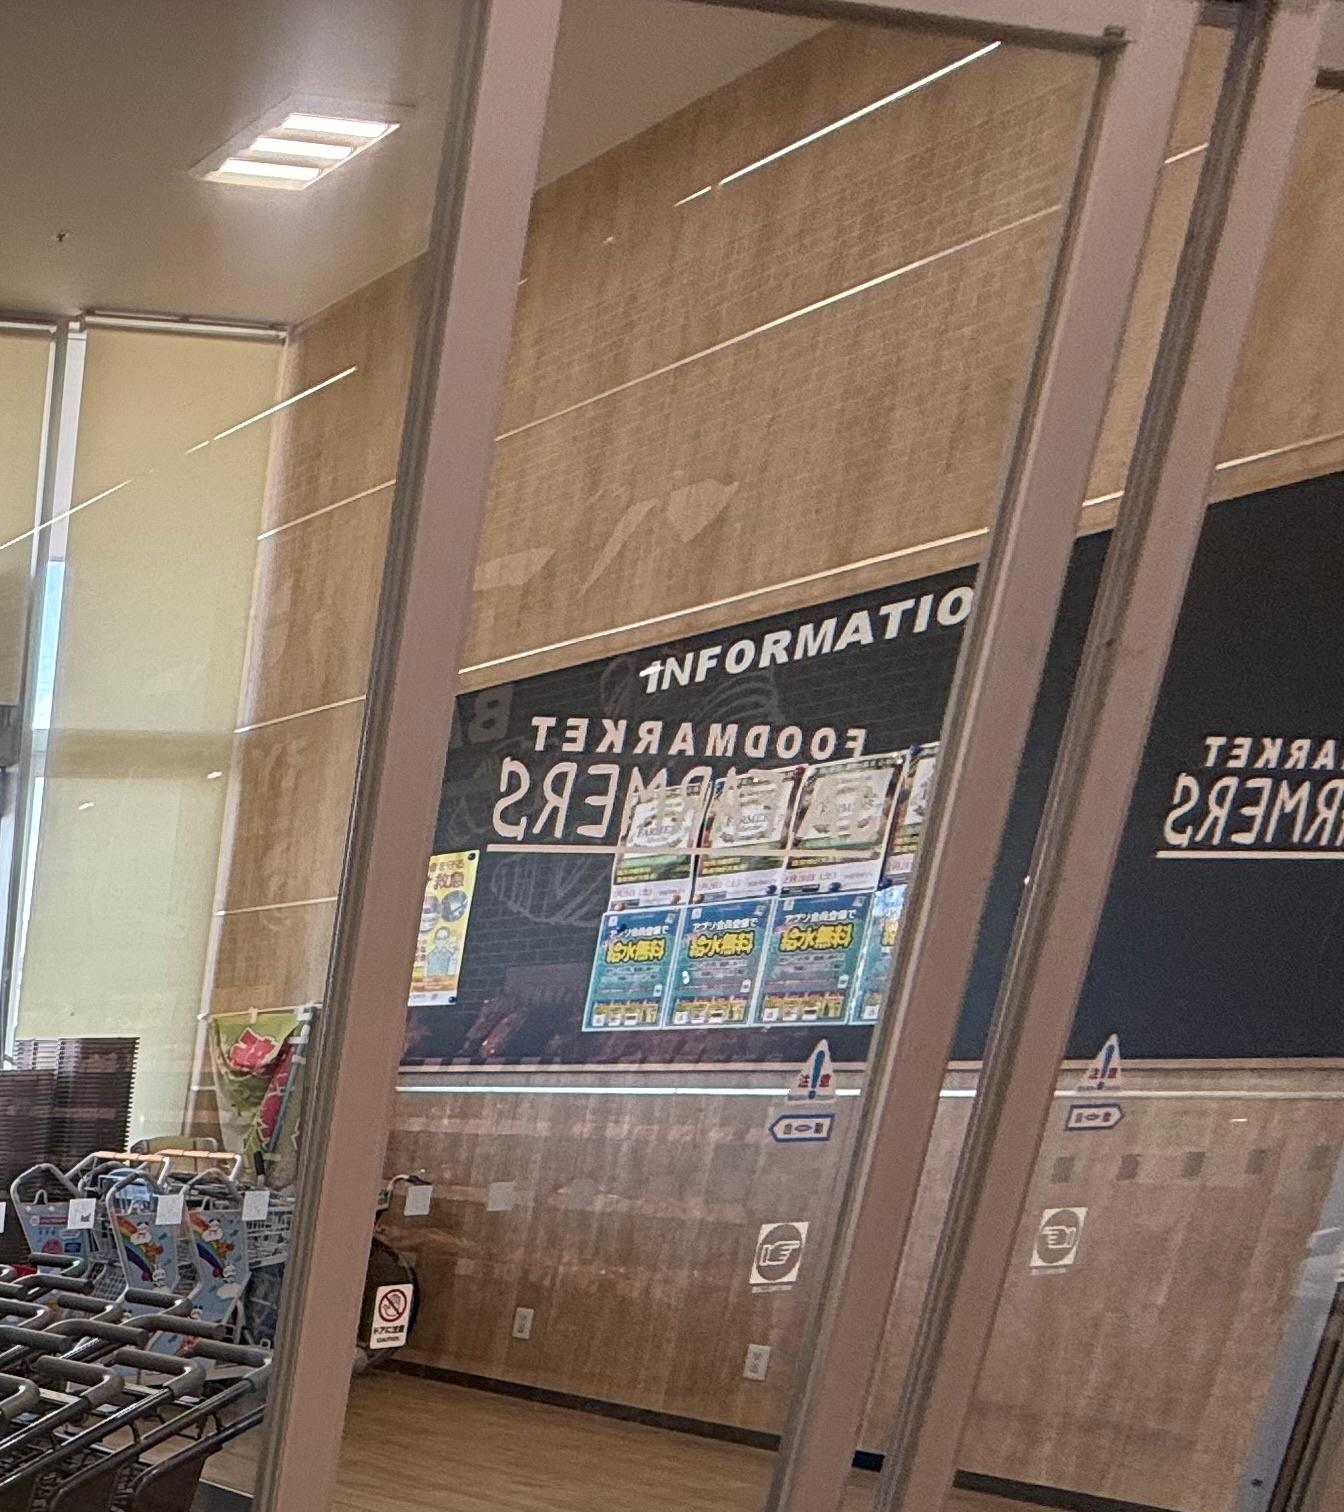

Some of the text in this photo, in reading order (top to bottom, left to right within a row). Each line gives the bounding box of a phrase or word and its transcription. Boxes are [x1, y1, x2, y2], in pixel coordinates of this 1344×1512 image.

[428, 871, 465, 890] 救急
[687, 930, 755, 959] 給水無料
[779, 923, 854, 952] 給水無料
